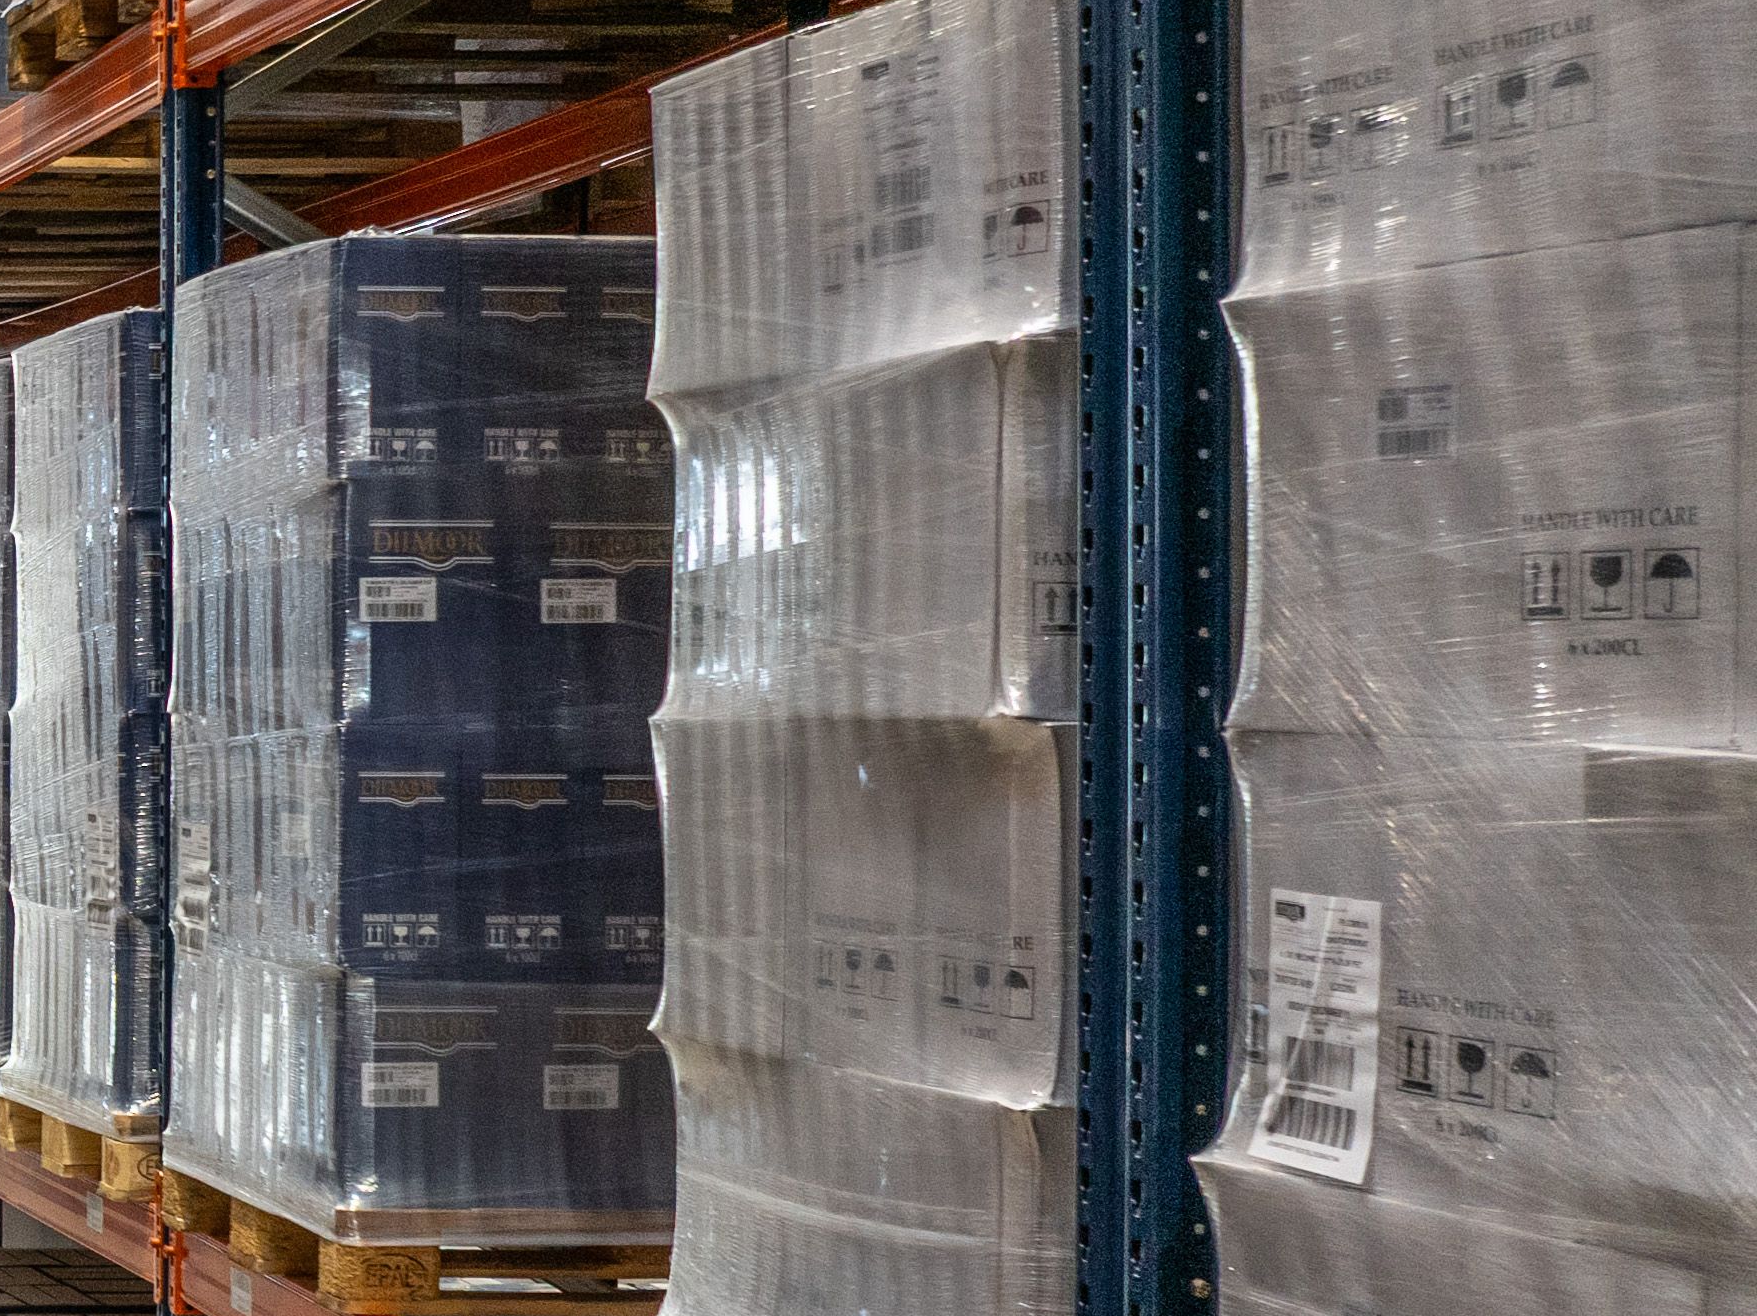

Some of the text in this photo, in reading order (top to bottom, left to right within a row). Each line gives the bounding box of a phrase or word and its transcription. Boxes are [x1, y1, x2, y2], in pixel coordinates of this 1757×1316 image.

[1596, 508, 1644, 528] WITH
[1649, 505, 1699, 527] CARE
[1034, 550, 1077, 567] HAN
